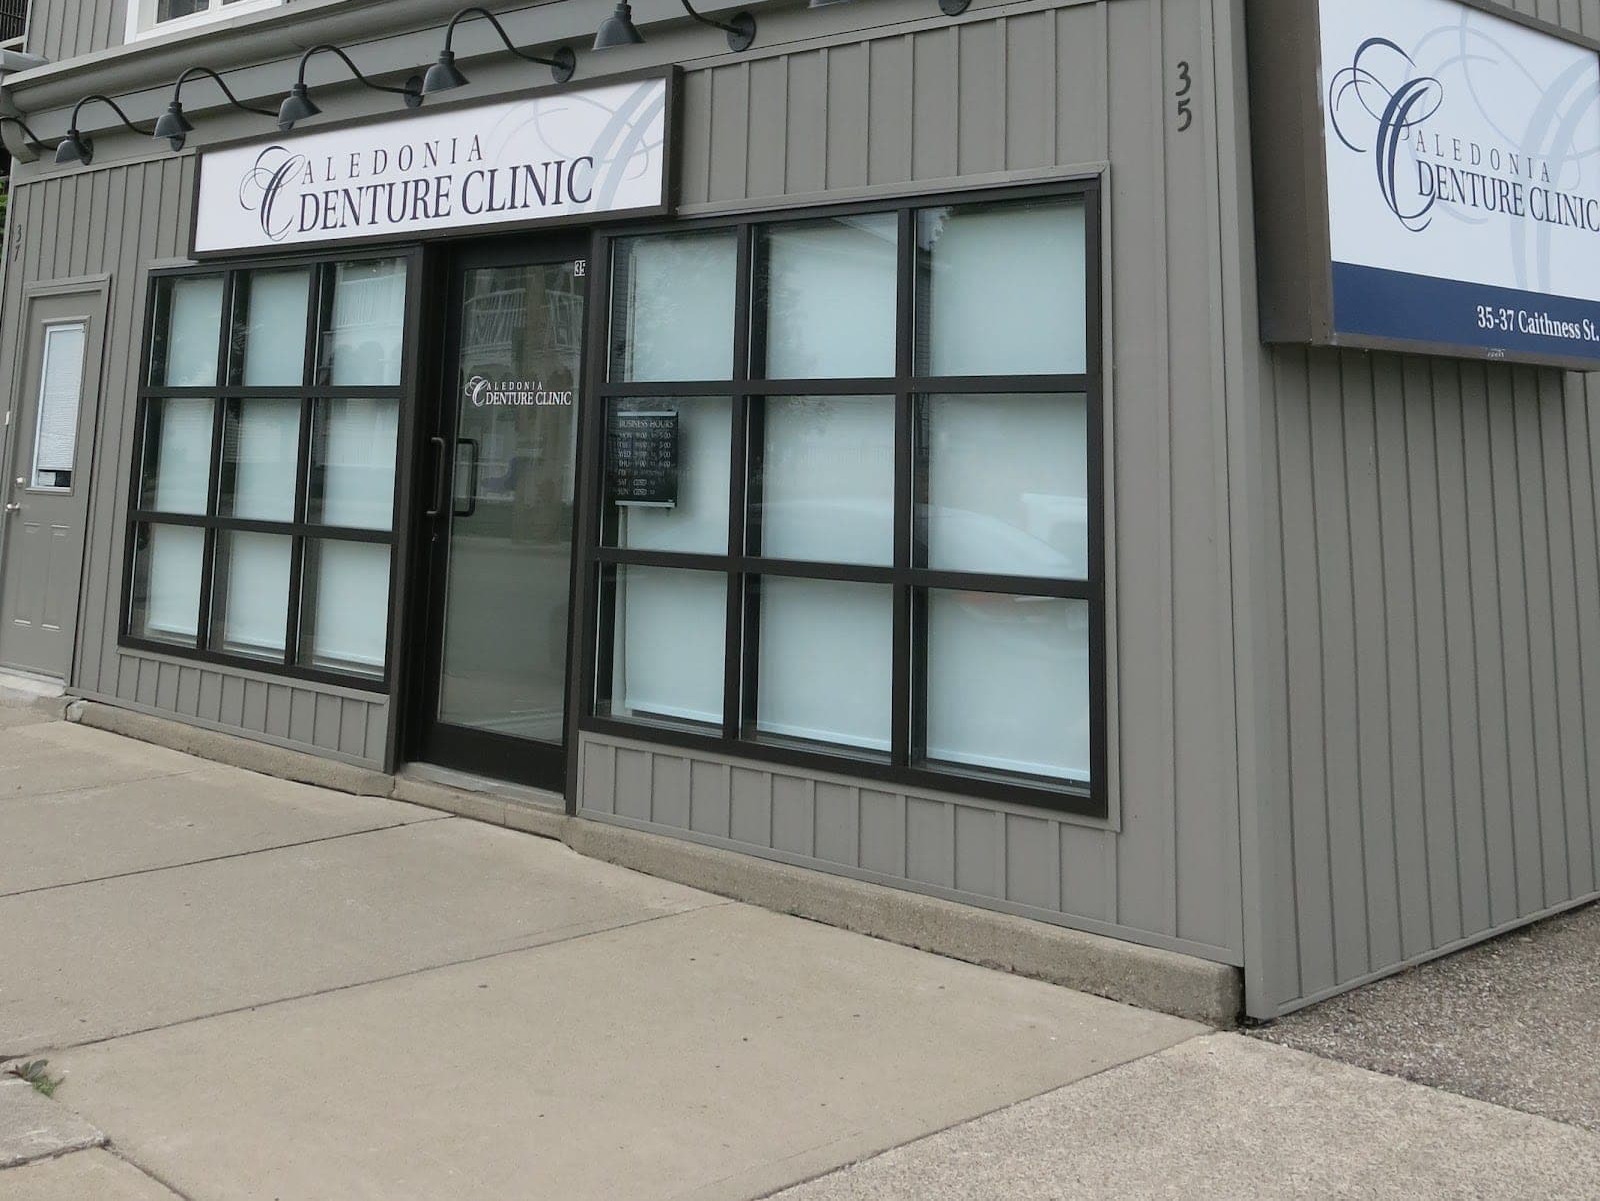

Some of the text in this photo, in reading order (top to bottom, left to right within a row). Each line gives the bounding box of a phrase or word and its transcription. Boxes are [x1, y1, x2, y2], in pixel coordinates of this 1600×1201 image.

[1176, 61, 1192, 132] 35
[1329, 37, 1552, 232] CALEDONIA
[240, 133, 485, 241] CALEDONIA
[297, 156, 594, 233] DENTURE CLINIC
[1416, 159, 1600, 232] DENTURE CLINIC
[1477, 305, 1600, 341] 35-37 Caithness St.
[465, 376, 543, 407] CALEDONIA
[486, 391, 571, 405] DENTURE CLINIC
